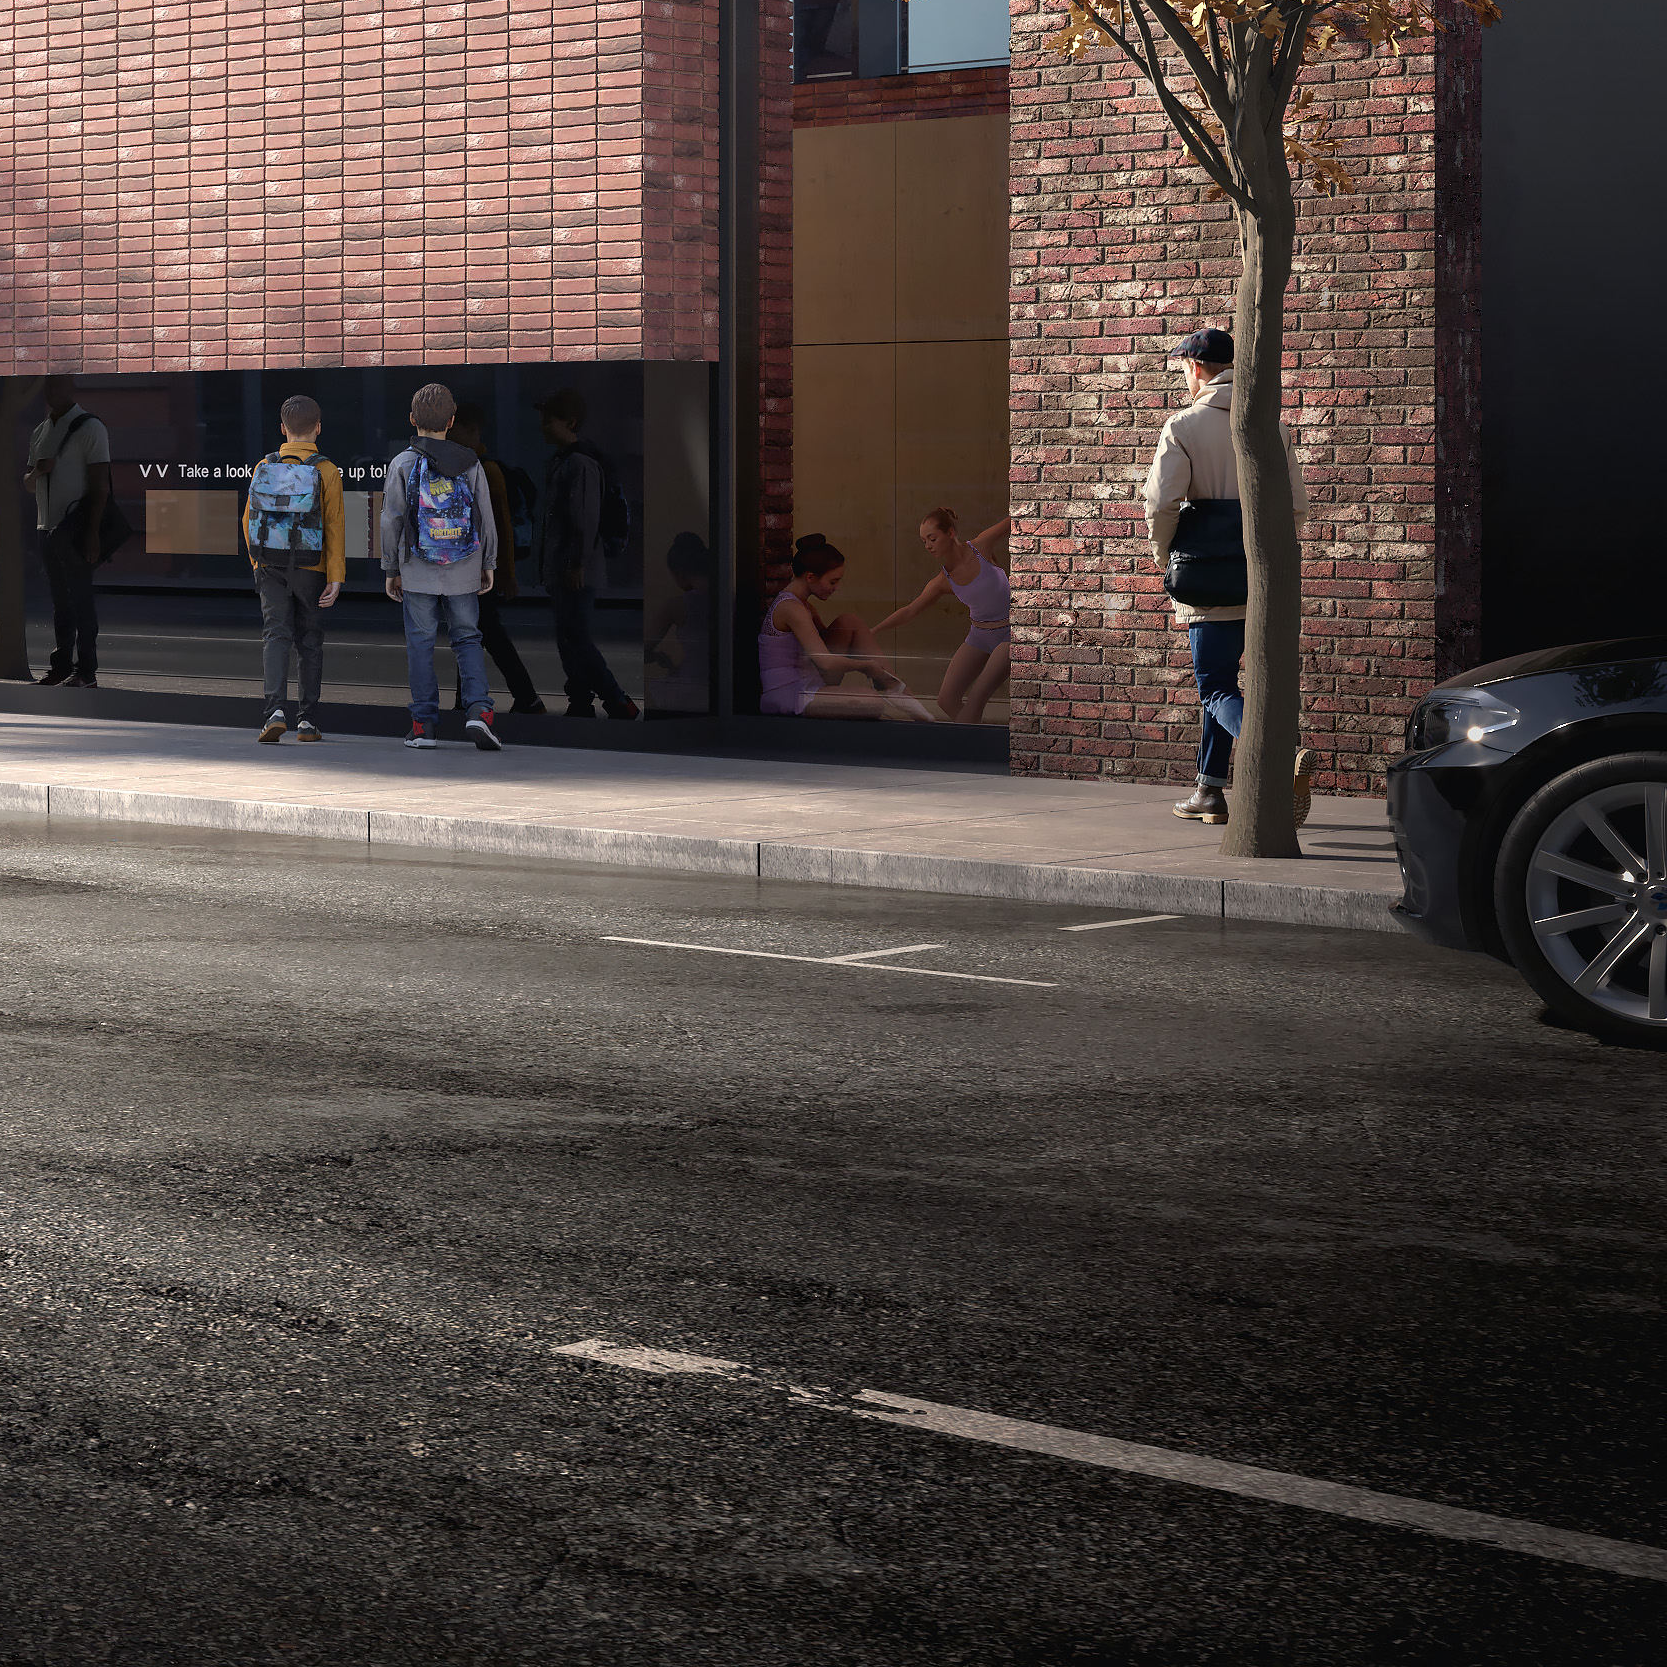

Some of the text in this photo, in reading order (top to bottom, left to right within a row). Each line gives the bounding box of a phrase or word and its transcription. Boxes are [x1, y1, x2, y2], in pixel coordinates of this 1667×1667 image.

[178, 464, 209, 479] Take
[213, 467, 222, 479] a
[226, 464, 253, 479] look
[348, 467, 366, 482] up
[370, 464, 387, 478] to!
[430, 527, 462, 537] FORTNITE
